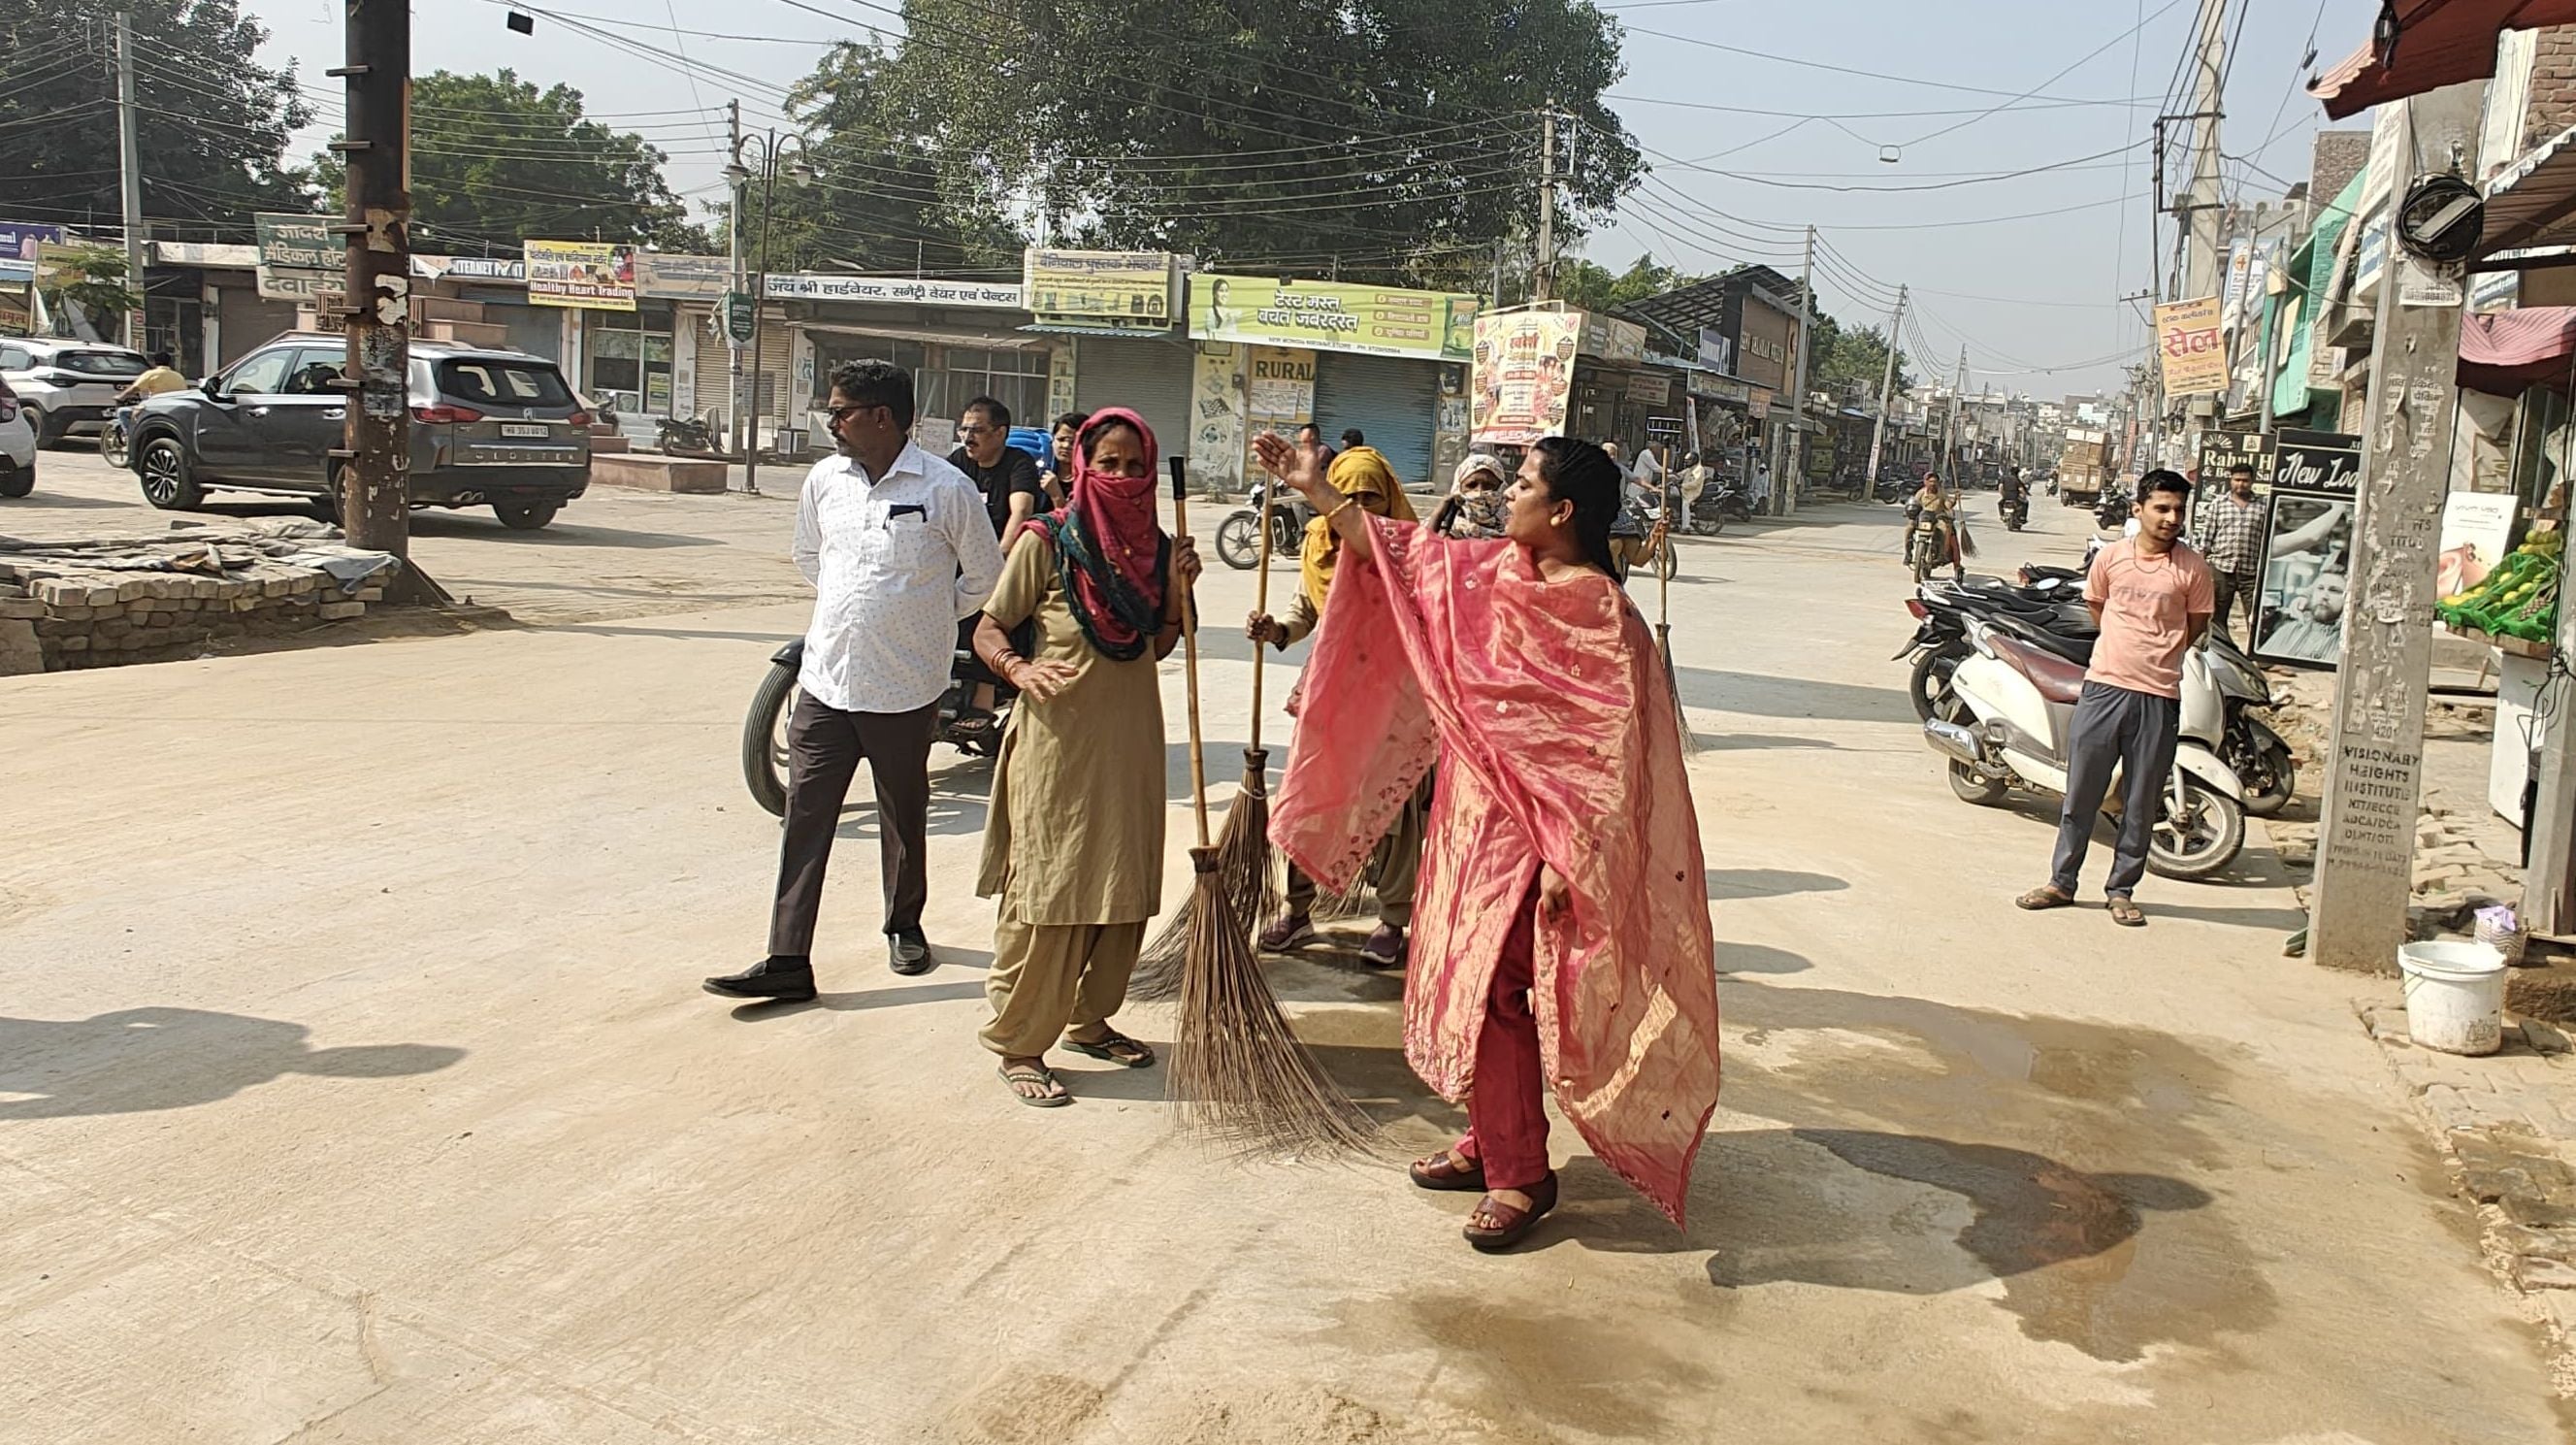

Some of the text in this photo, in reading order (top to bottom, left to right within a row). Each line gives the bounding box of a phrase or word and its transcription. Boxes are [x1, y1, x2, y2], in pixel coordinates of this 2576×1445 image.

[531, 281, 567, 296] Healthy
[569, 283, 596, 296] Heart
[599, 285, 635, 300] Trading
[767, 281, 795, 293] जय
[799, 280, 818, 294] श्री
[1275, 289, 1304, 309] टेस्ट
[1257, 308, 1359, 334] बचत जबरदस्त
[2162, 327, 2219, 357] सेल
[1255, 360, 1315, 381] RURAL
[2278, 451, 2359, 488] New Loo
[2344, 745, 2419, 767] VISIONARY
[2350, 764, 2410, 783] HEIGHTS
[2344, 780, 2409, 801] INSTITUTE
